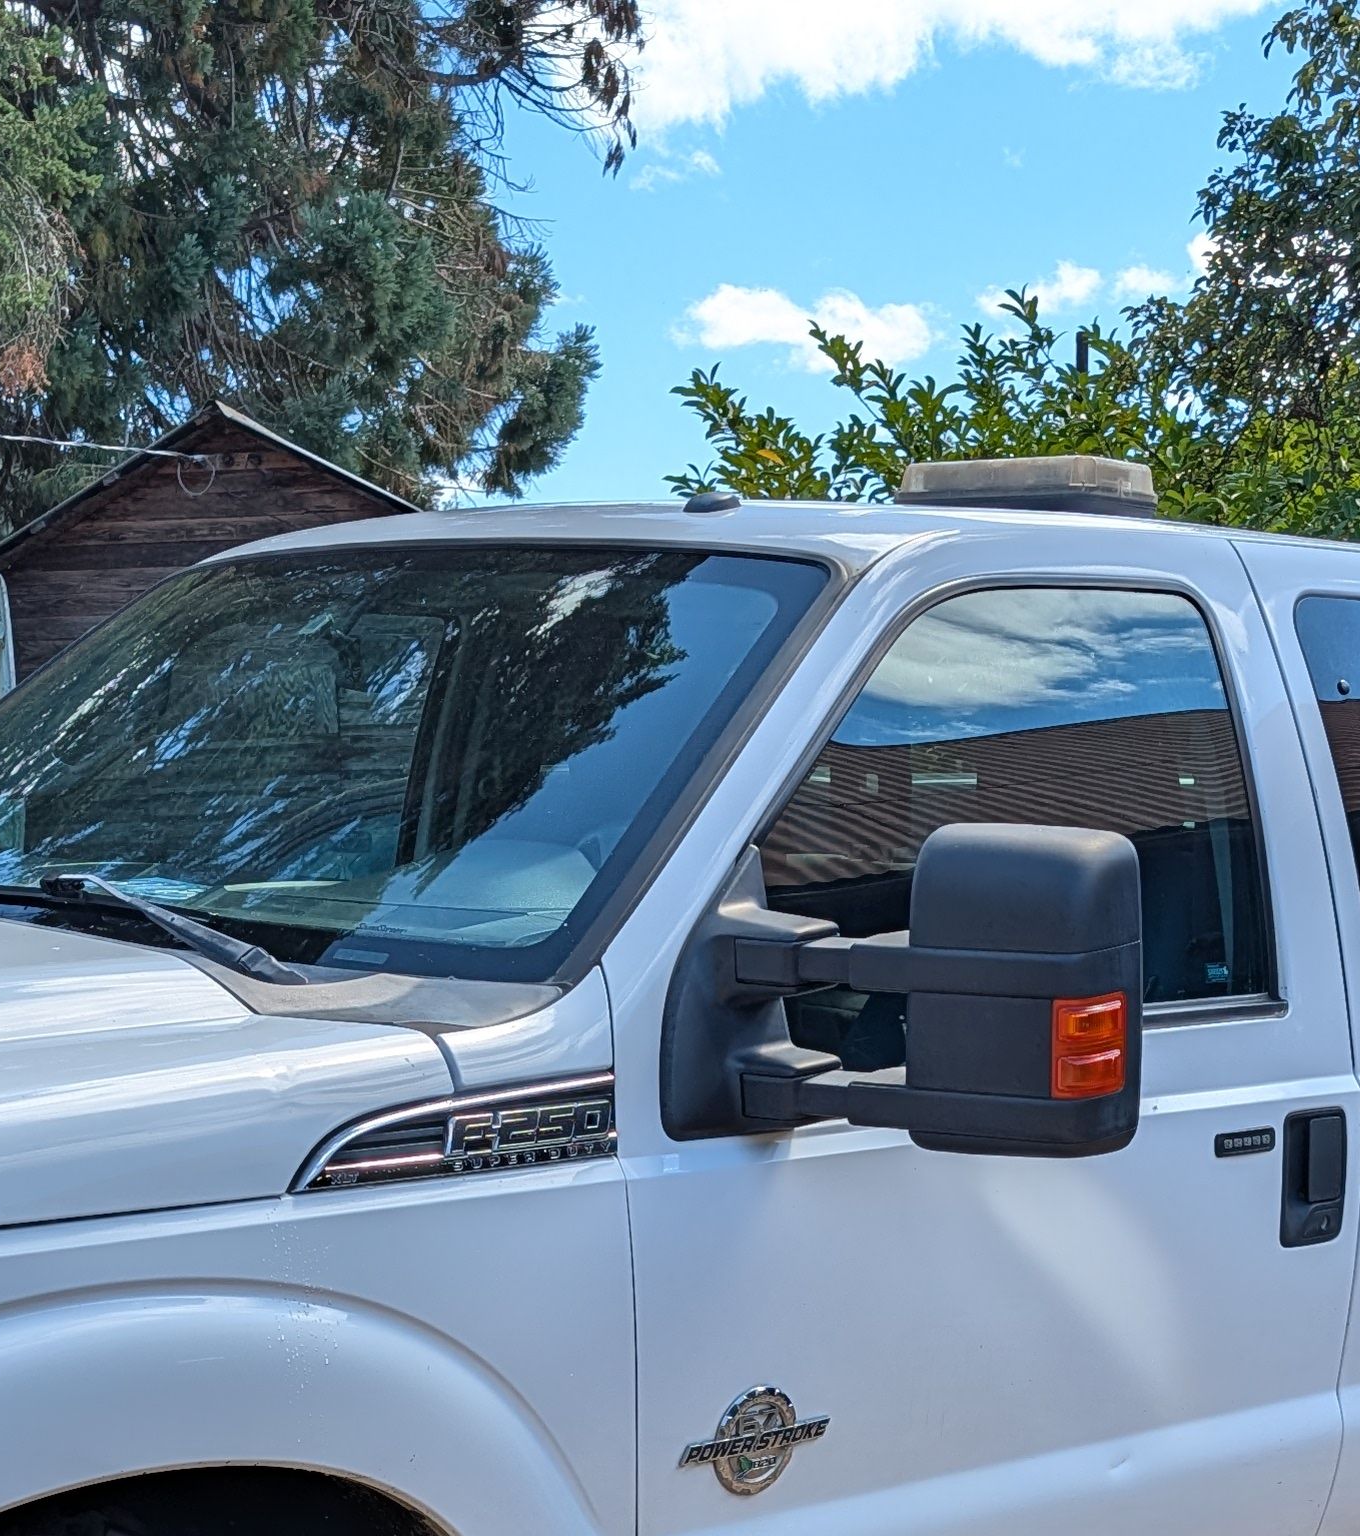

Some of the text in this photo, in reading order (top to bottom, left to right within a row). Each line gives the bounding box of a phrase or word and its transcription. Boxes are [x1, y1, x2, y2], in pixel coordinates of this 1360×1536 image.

[451, 1141, 612, 1172] SUPER DUTY
[685, 1417, 831, 1464] POWER STROKE
